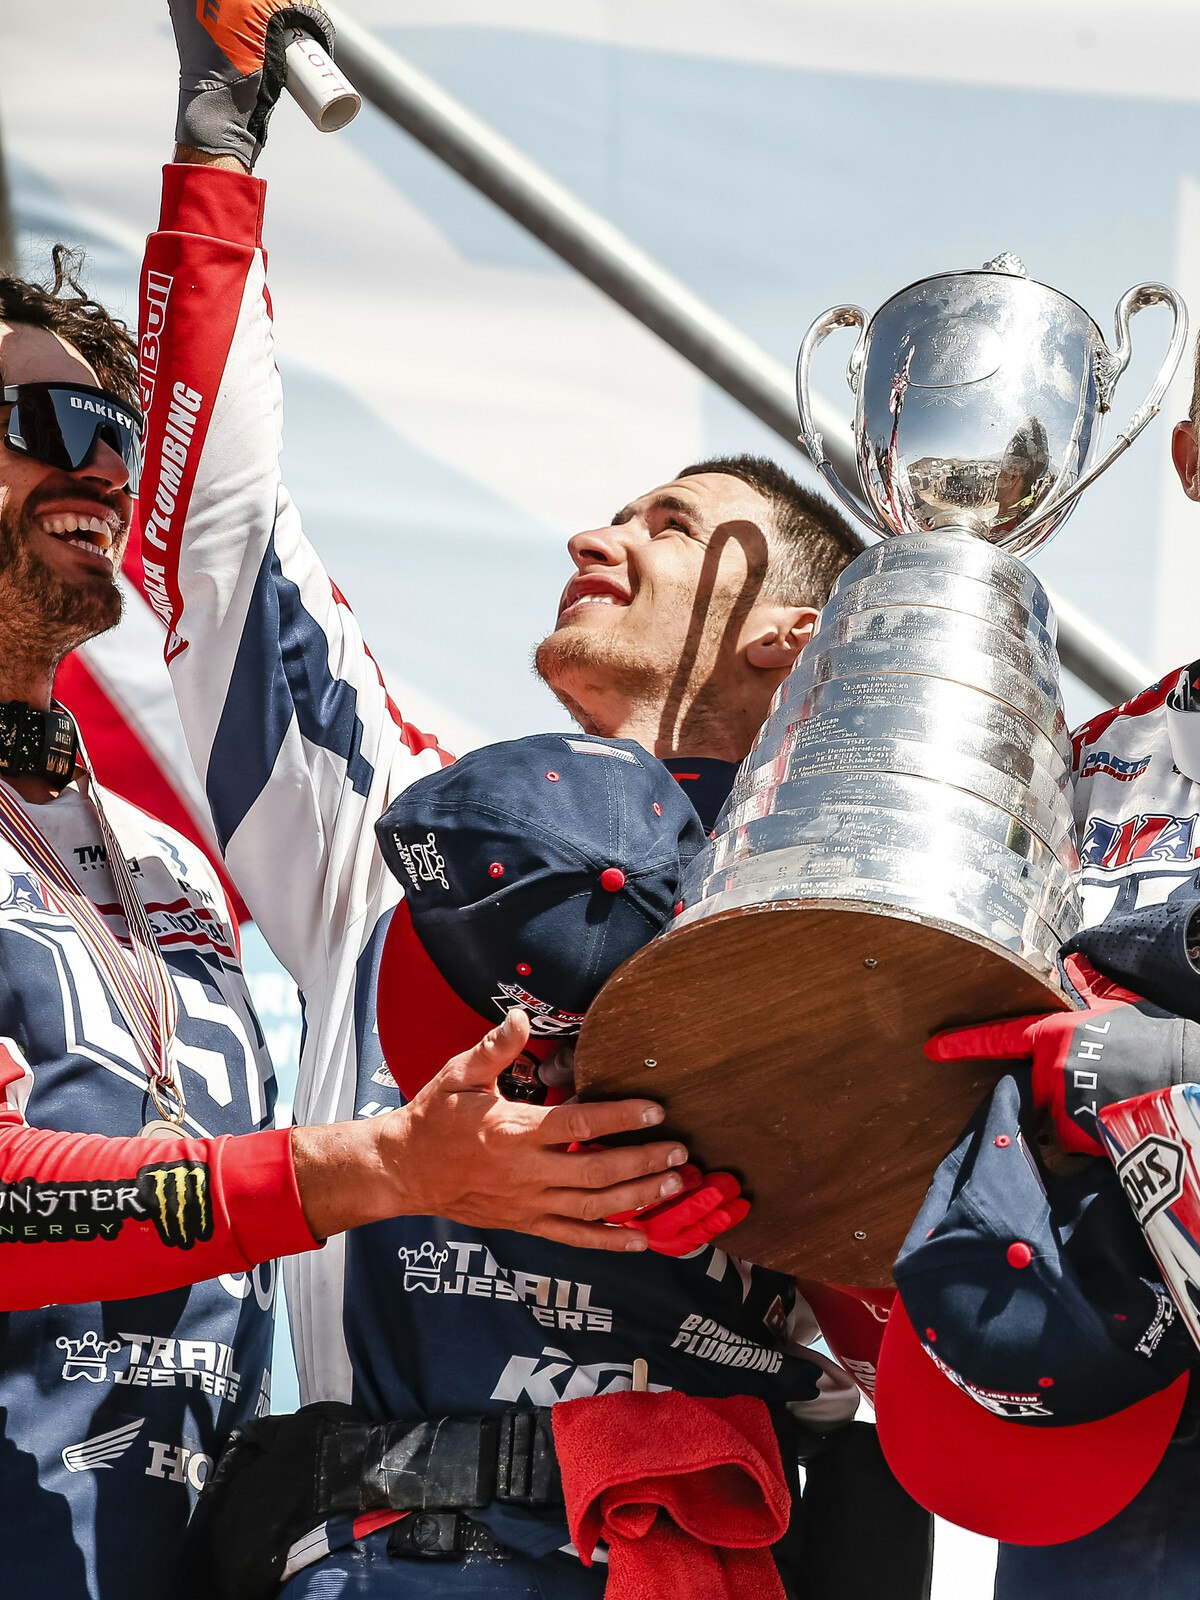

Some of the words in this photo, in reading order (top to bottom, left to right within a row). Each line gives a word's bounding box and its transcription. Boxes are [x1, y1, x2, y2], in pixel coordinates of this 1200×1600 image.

[69, 396, 132, 430] OAKLEY
[144, 380, 203, 551] PLUMBING
[1083, 751, 1152, 774] PARTS
[1080, 812, 1200, 870] AMA
[0, 1184, 146, 1217] NSTER
[1122, 1147, 1171, 1212] SHO
[0, 1223, 114, 1236] NERGY
[443, 1274, 613, 1333] JESERS
[118, 1332, 241, 1381] TRAIL
[670, 1331, 783, 1374] PLUMBING
